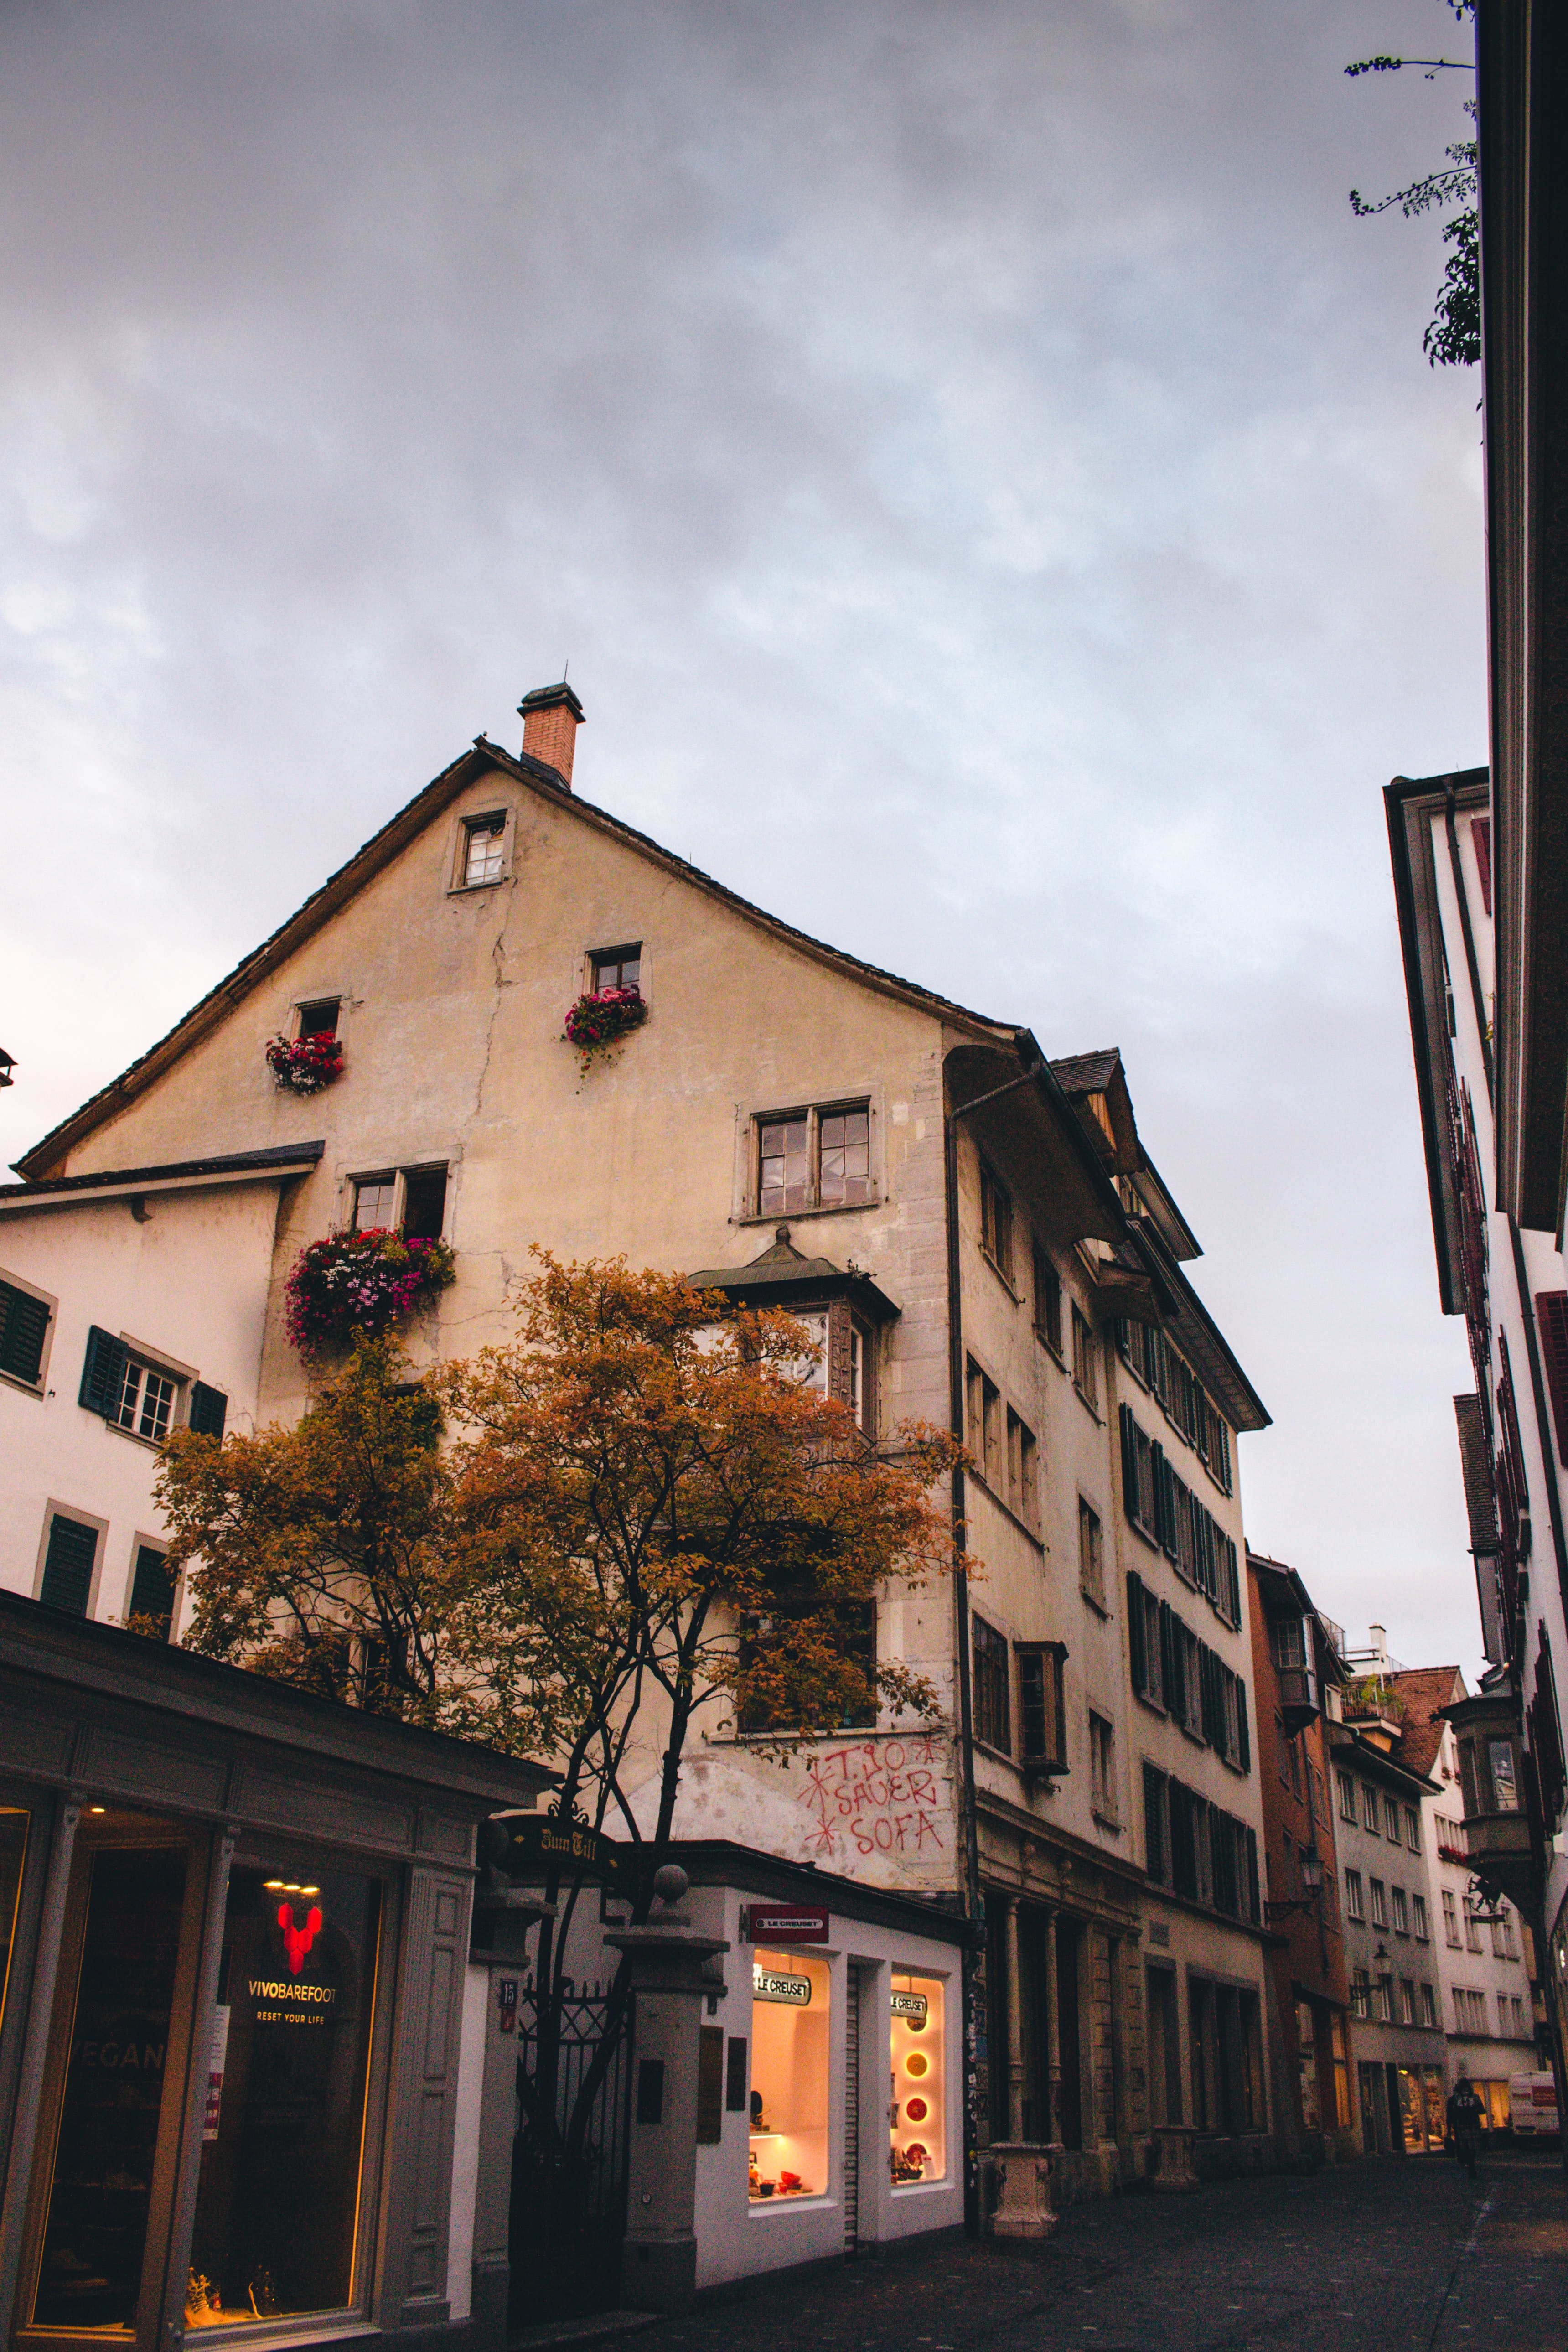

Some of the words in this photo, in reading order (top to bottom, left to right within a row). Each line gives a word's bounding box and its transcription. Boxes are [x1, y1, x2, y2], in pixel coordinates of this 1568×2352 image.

[851, 1810, 943, 1855] SOFA
[249, 1980, 337, 2003] VIVOBAREFOOT
[504, 1984, 515, 2004] 15
[758, 1977, 768, 1991] LE
[770, 1980, 807, 1996] CREUSET
[898, 1998, 925, 2011] CREUSET
[257, 2011, 282, 2021] RESET
[284, 2013, 305, 2023] YOUR
[308, 2015, 324, 2025] LIFE
